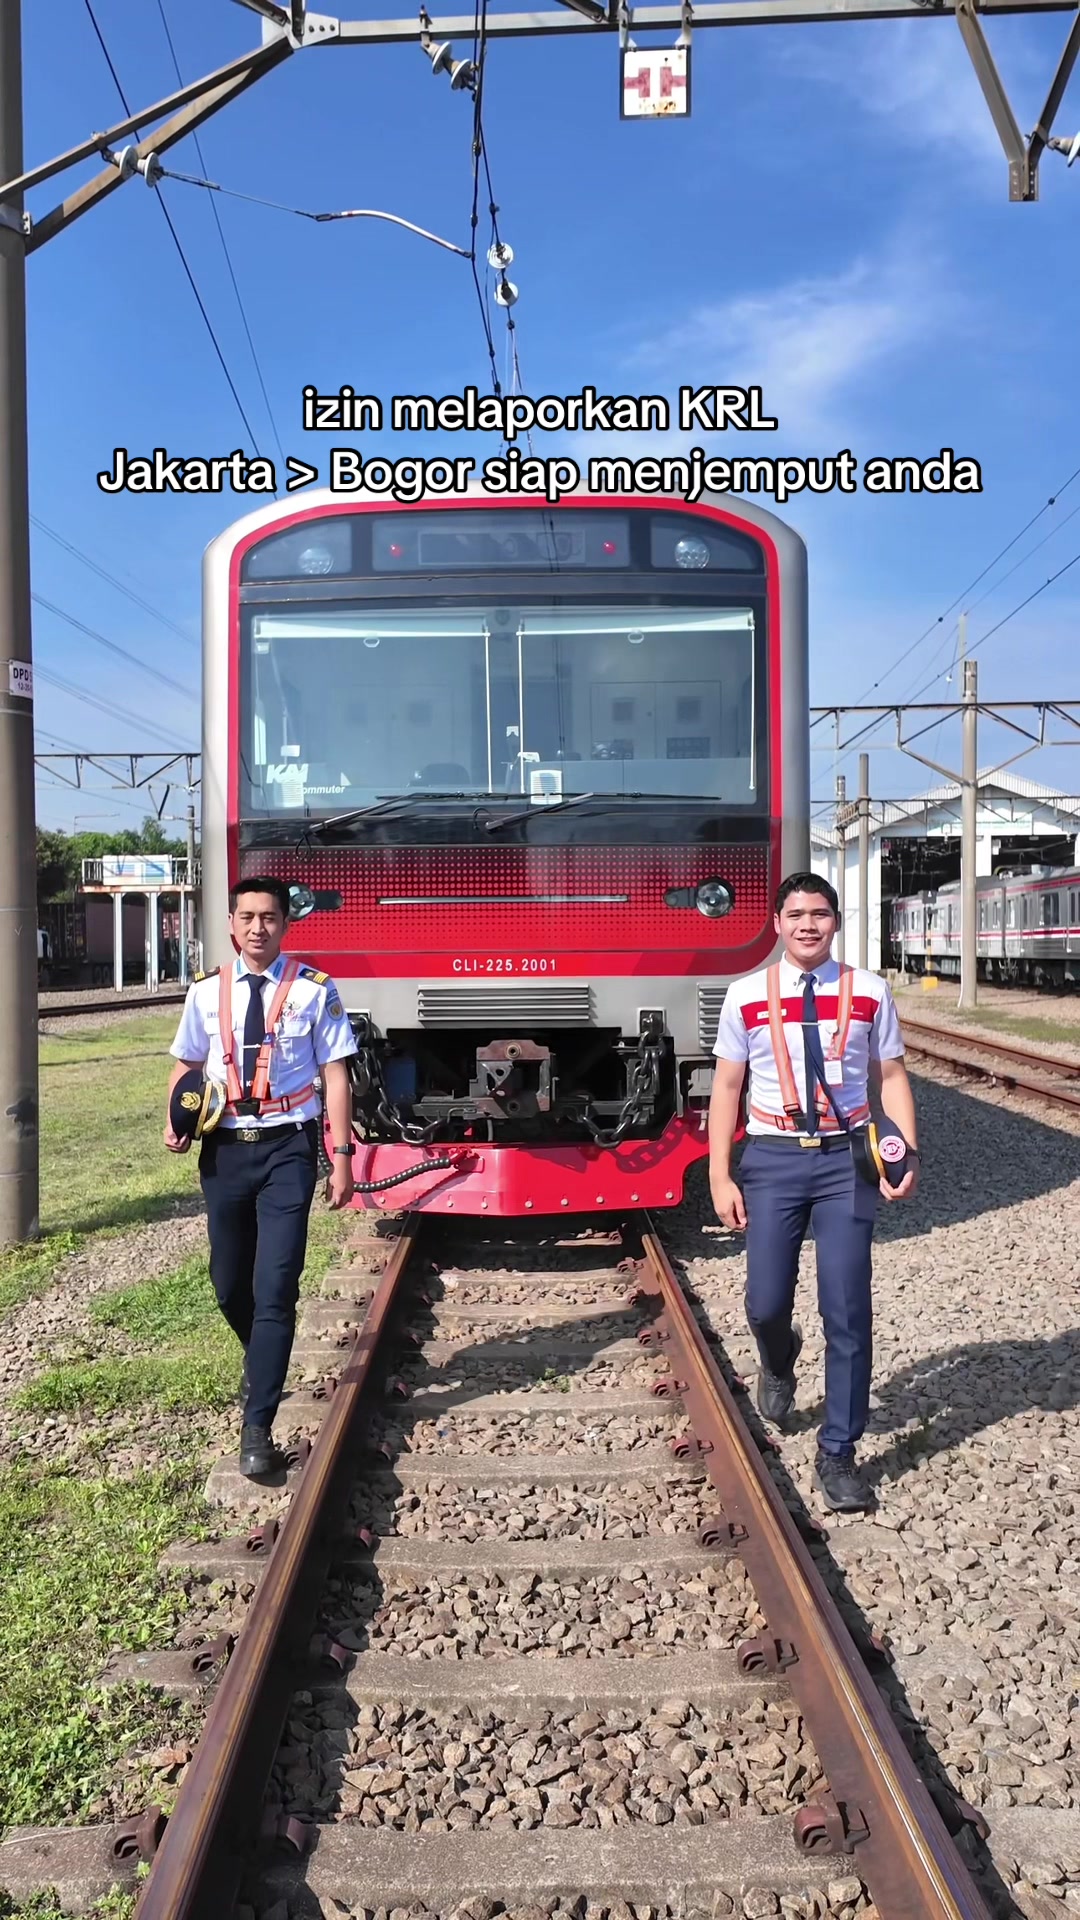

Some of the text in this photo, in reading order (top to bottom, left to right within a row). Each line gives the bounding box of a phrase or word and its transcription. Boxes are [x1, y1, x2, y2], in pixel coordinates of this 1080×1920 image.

[266, 763, 309, 784] KAI
[301, 785, 346, 795] ommuter
[452, 958, 557, 971] CLI-225.2001
